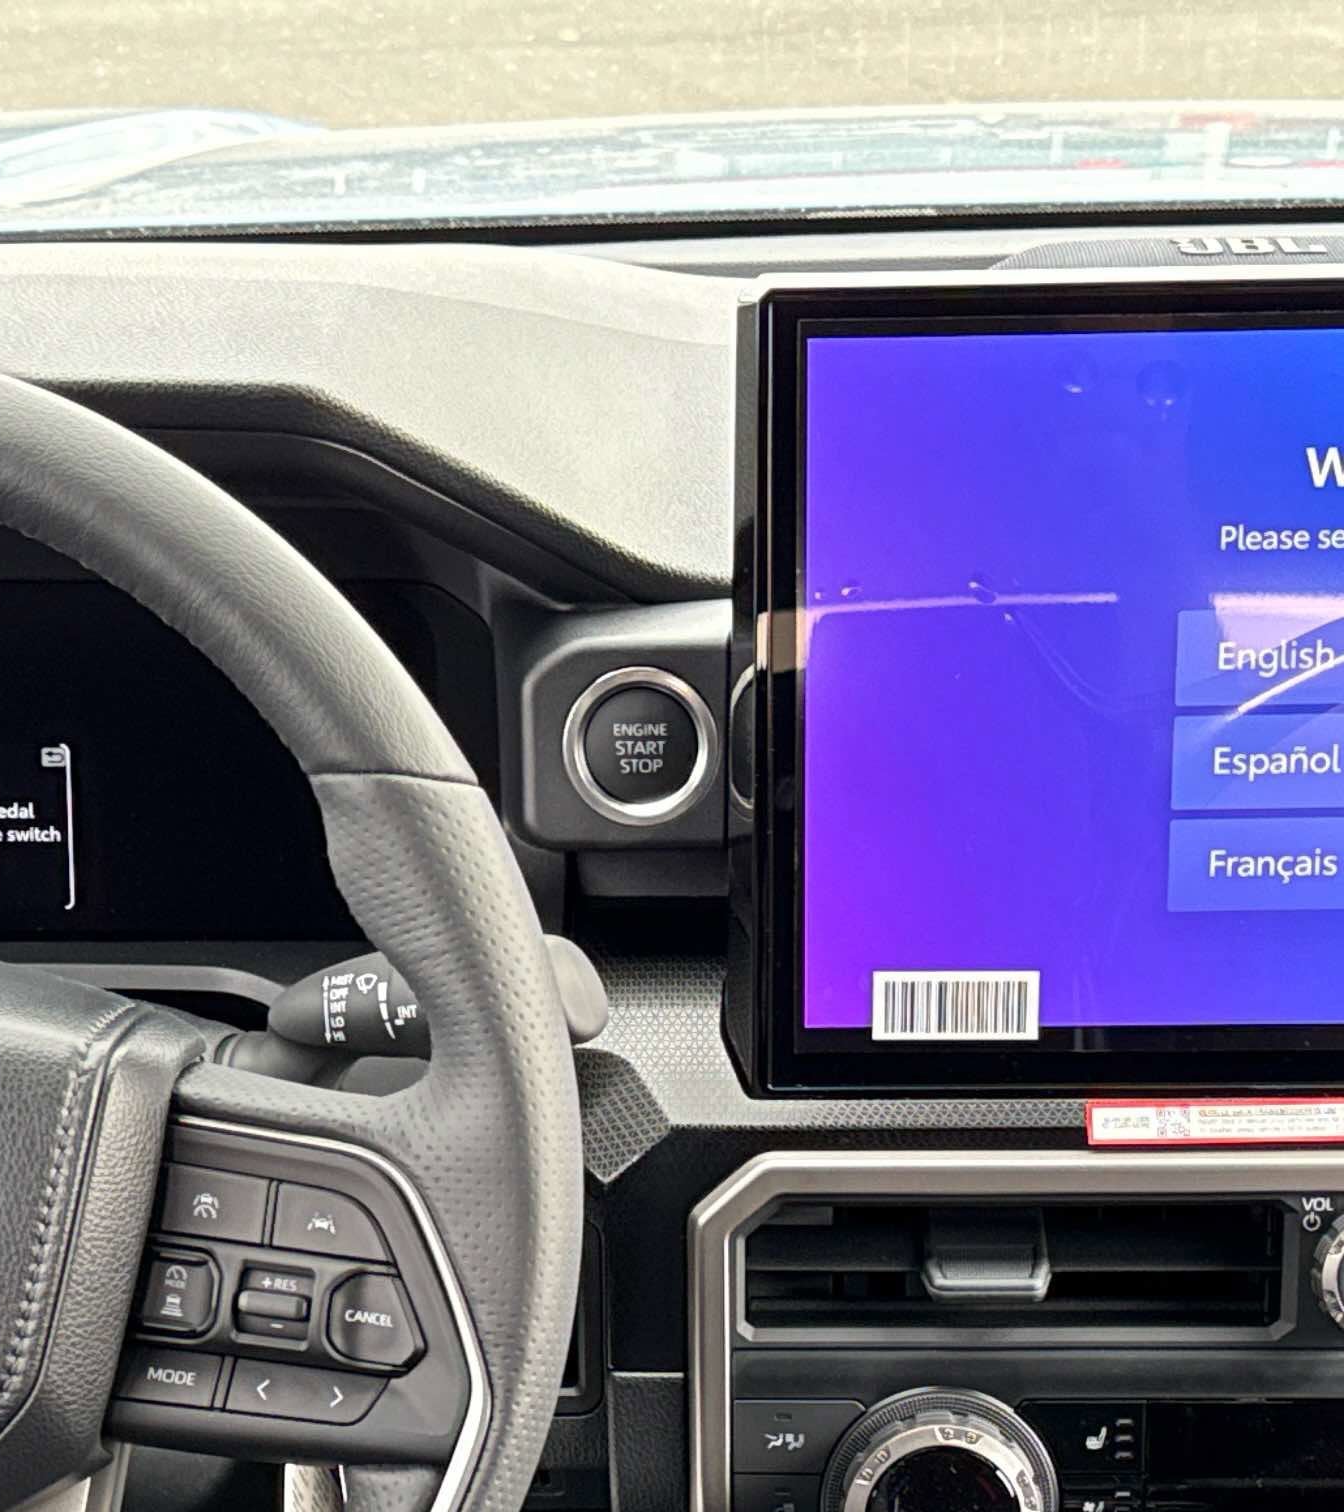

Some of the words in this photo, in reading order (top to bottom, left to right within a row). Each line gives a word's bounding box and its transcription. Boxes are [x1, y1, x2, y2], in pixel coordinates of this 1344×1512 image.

[1169, 236, 1329, 256] JBL
[1220, 524, 1312, 552] Please
[1217, 640, 1335, 678] English
[613, 723, 668, 736] ENGINE
[615, 740, 666, 756] START
[620, 758, 664, 774] STOP
[1213, 744, 1342, 782] Español
[6, 825, 61, 842] switch
[1208, 847, 1338, 885] Français
[329, 988, 349, 1000] OFF
[397, 1005, 417, 1019] INT
[331, 1016, 345, 1028] LO
[1302, 1197, 1334, 1212] VOL
[345, 1309, 394, 1328] CANCEL
[147, 1366, 197, 1387] MODE
